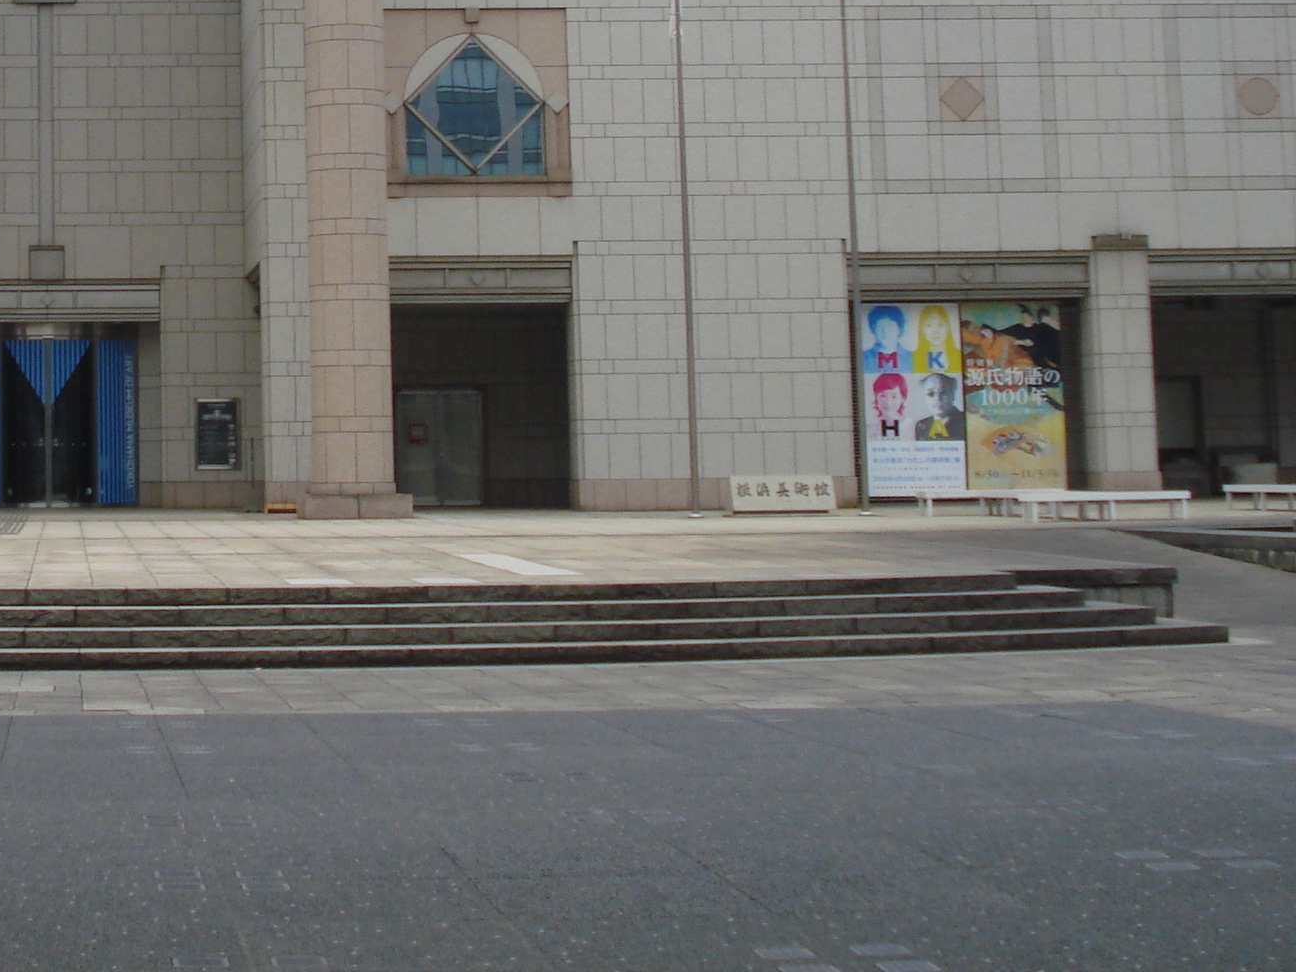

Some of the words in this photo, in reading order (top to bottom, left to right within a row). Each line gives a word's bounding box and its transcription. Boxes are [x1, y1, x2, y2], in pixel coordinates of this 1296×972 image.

[877, 351, 898, 369] M
[927, 351, 946, 369] K
[964, 367, 1061, 386] 源氏物語の
[980, 387, 1049, 406] 1000年
[881, 419, 900, 437] H
[928, 419, 950, 438] A
